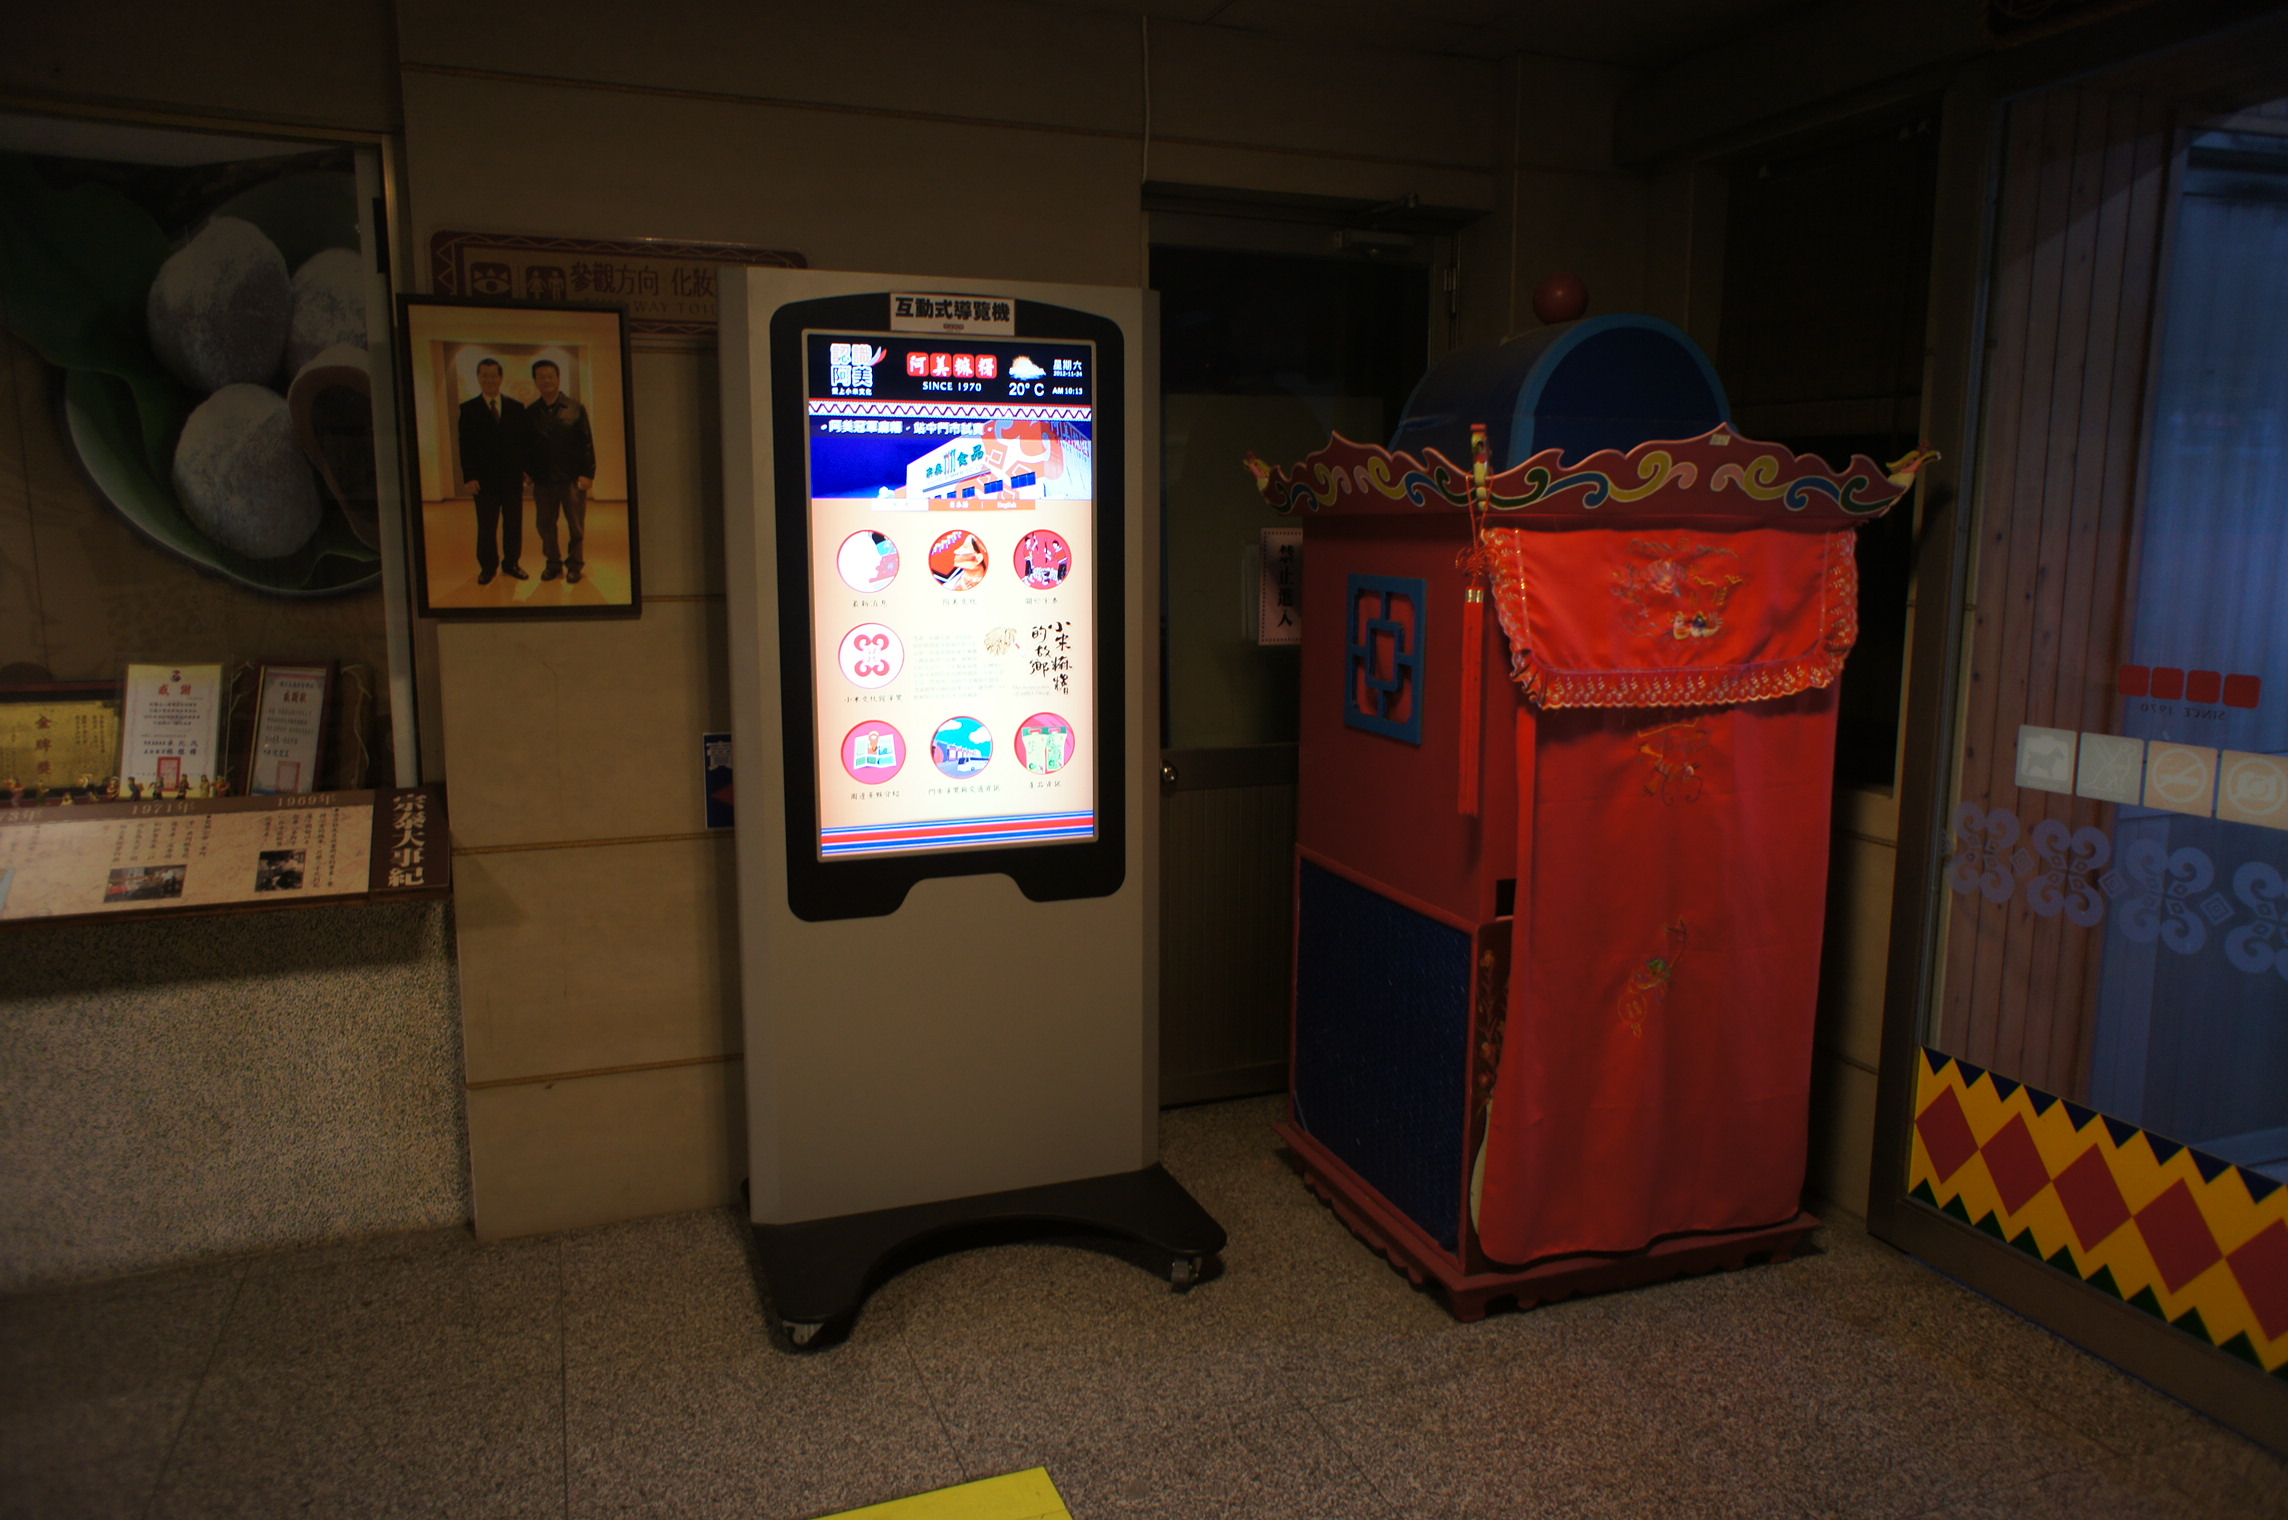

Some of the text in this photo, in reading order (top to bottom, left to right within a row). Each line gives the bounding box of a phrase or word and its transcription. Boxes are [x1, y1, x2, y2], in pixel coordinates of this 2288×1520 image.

[570, 260, 718, 298] 參觀方向 化妝
[634, 300, 670, 313] WAY
[895, 297, 1010, 322] 互動式導覽機
[1053, 359, 1082, 371] 星期六
[830, 365, 873, 388] 阿美
[922, 381, 982, 392] SINCE 1970
[1052, 387, 1064, 395] AM
[388, 793, 428, 888] 宗泰大事紀
